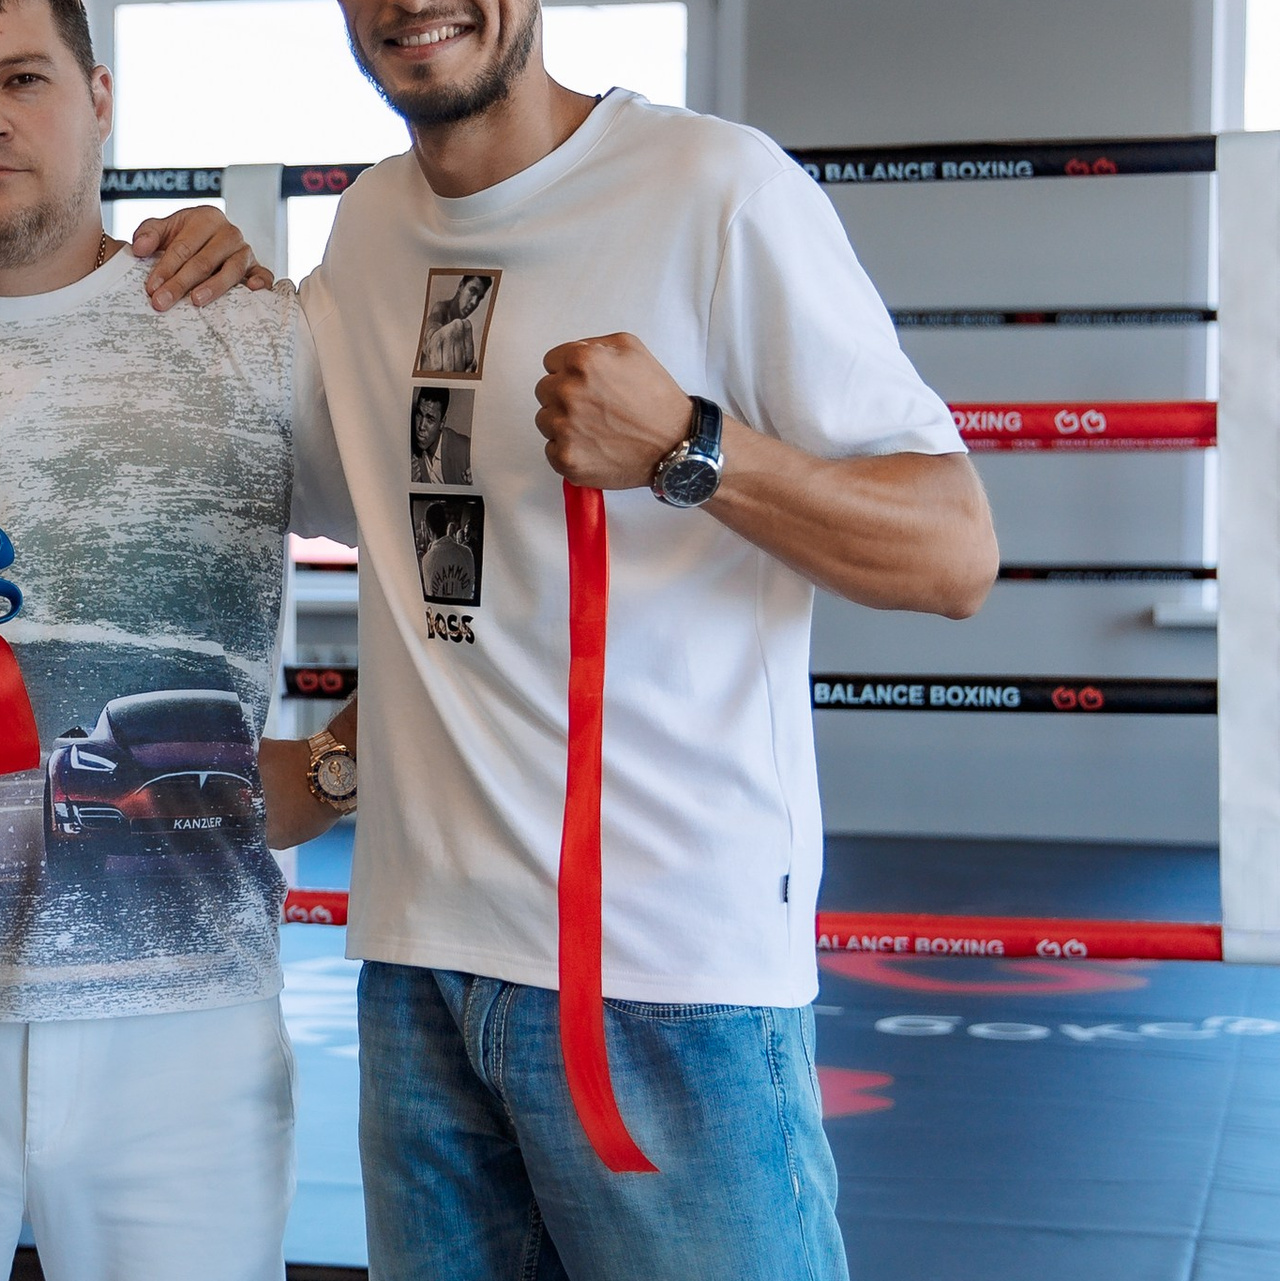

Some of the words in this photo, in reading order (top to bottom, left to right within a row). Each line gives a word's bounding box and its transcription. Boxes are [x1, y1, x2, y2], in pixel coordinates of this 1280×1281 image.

[101, 170, 189, 192] ALANCE
[825, 162, 936, 182] BALANCE
[941, 160, 1034, 179] BOXING
[951, 411, 1023, 432] OXING
[814, 683, 925, 706] BALANCE
[930, 685, 1020, 708] BOXING
[815, 933, 910, 952] ALANCE
[915, 937, 1005, 957] BOXING
